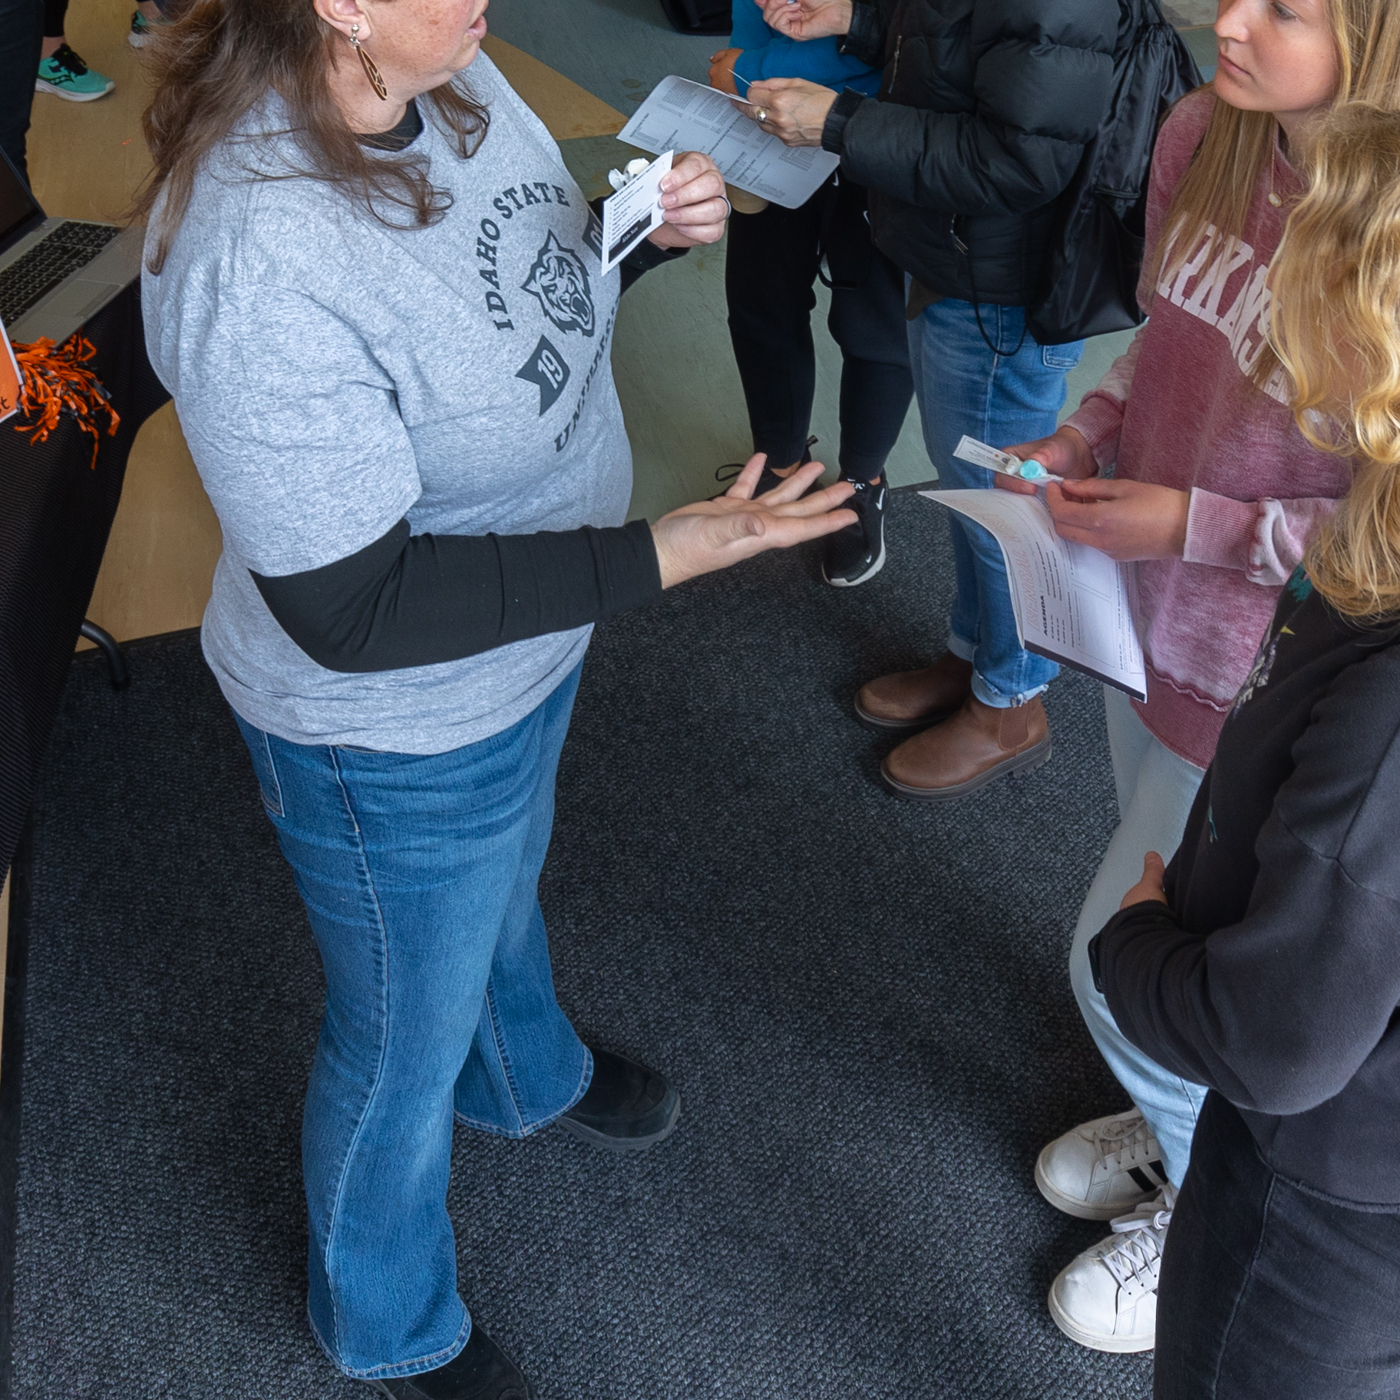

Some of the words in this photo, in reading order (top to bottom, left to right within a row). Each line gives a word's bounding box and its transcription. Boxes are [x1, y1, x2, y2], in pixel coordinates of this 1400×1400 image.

[493, 182, 570, 220] STATE
[476, 218, 515, 331] IDAHO
[537, 349, 564, 389] 19
[1040, 595, 1048, 635] AGENDA
